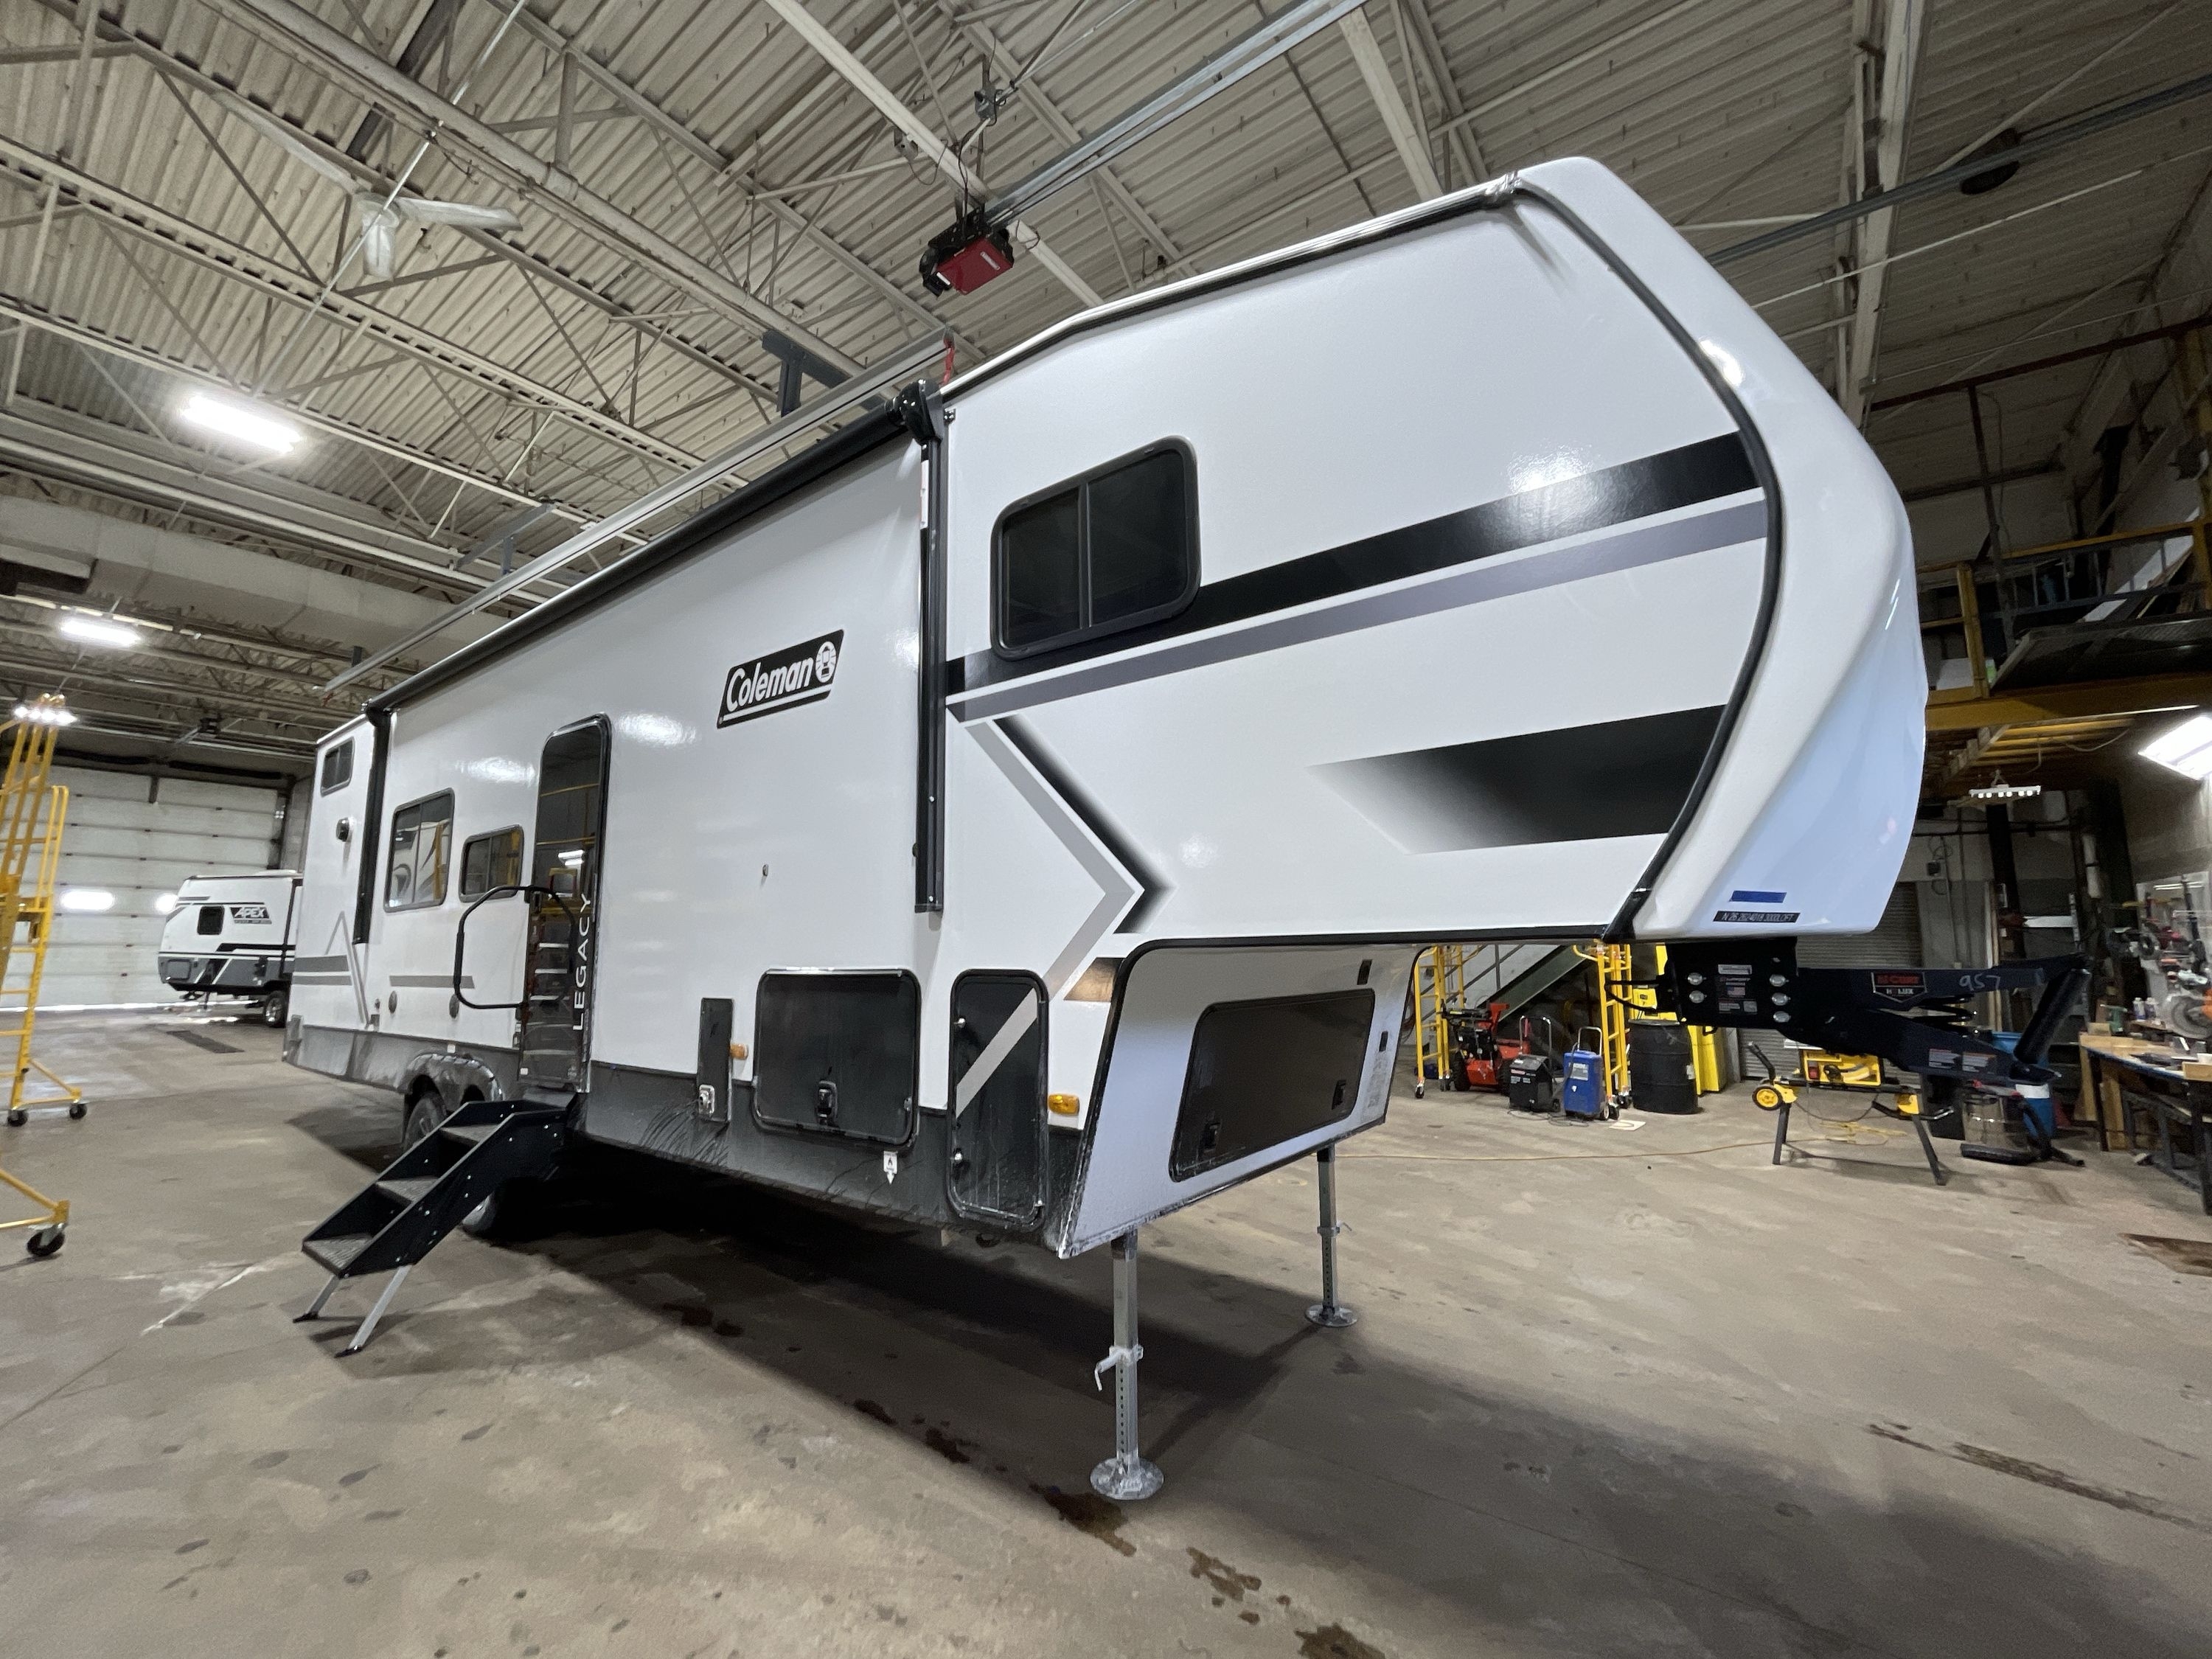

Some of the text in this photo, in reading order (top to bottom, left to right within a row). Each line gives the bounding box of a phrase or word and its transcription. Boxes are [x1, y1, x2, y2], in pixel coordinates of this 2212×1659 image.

[726, 656, 814, 712] Coleman
[234, 907, 265, 919] APEX
[572, 893, 591, 1032] LEGACY
[1959, 973, 2000, 991] 957
